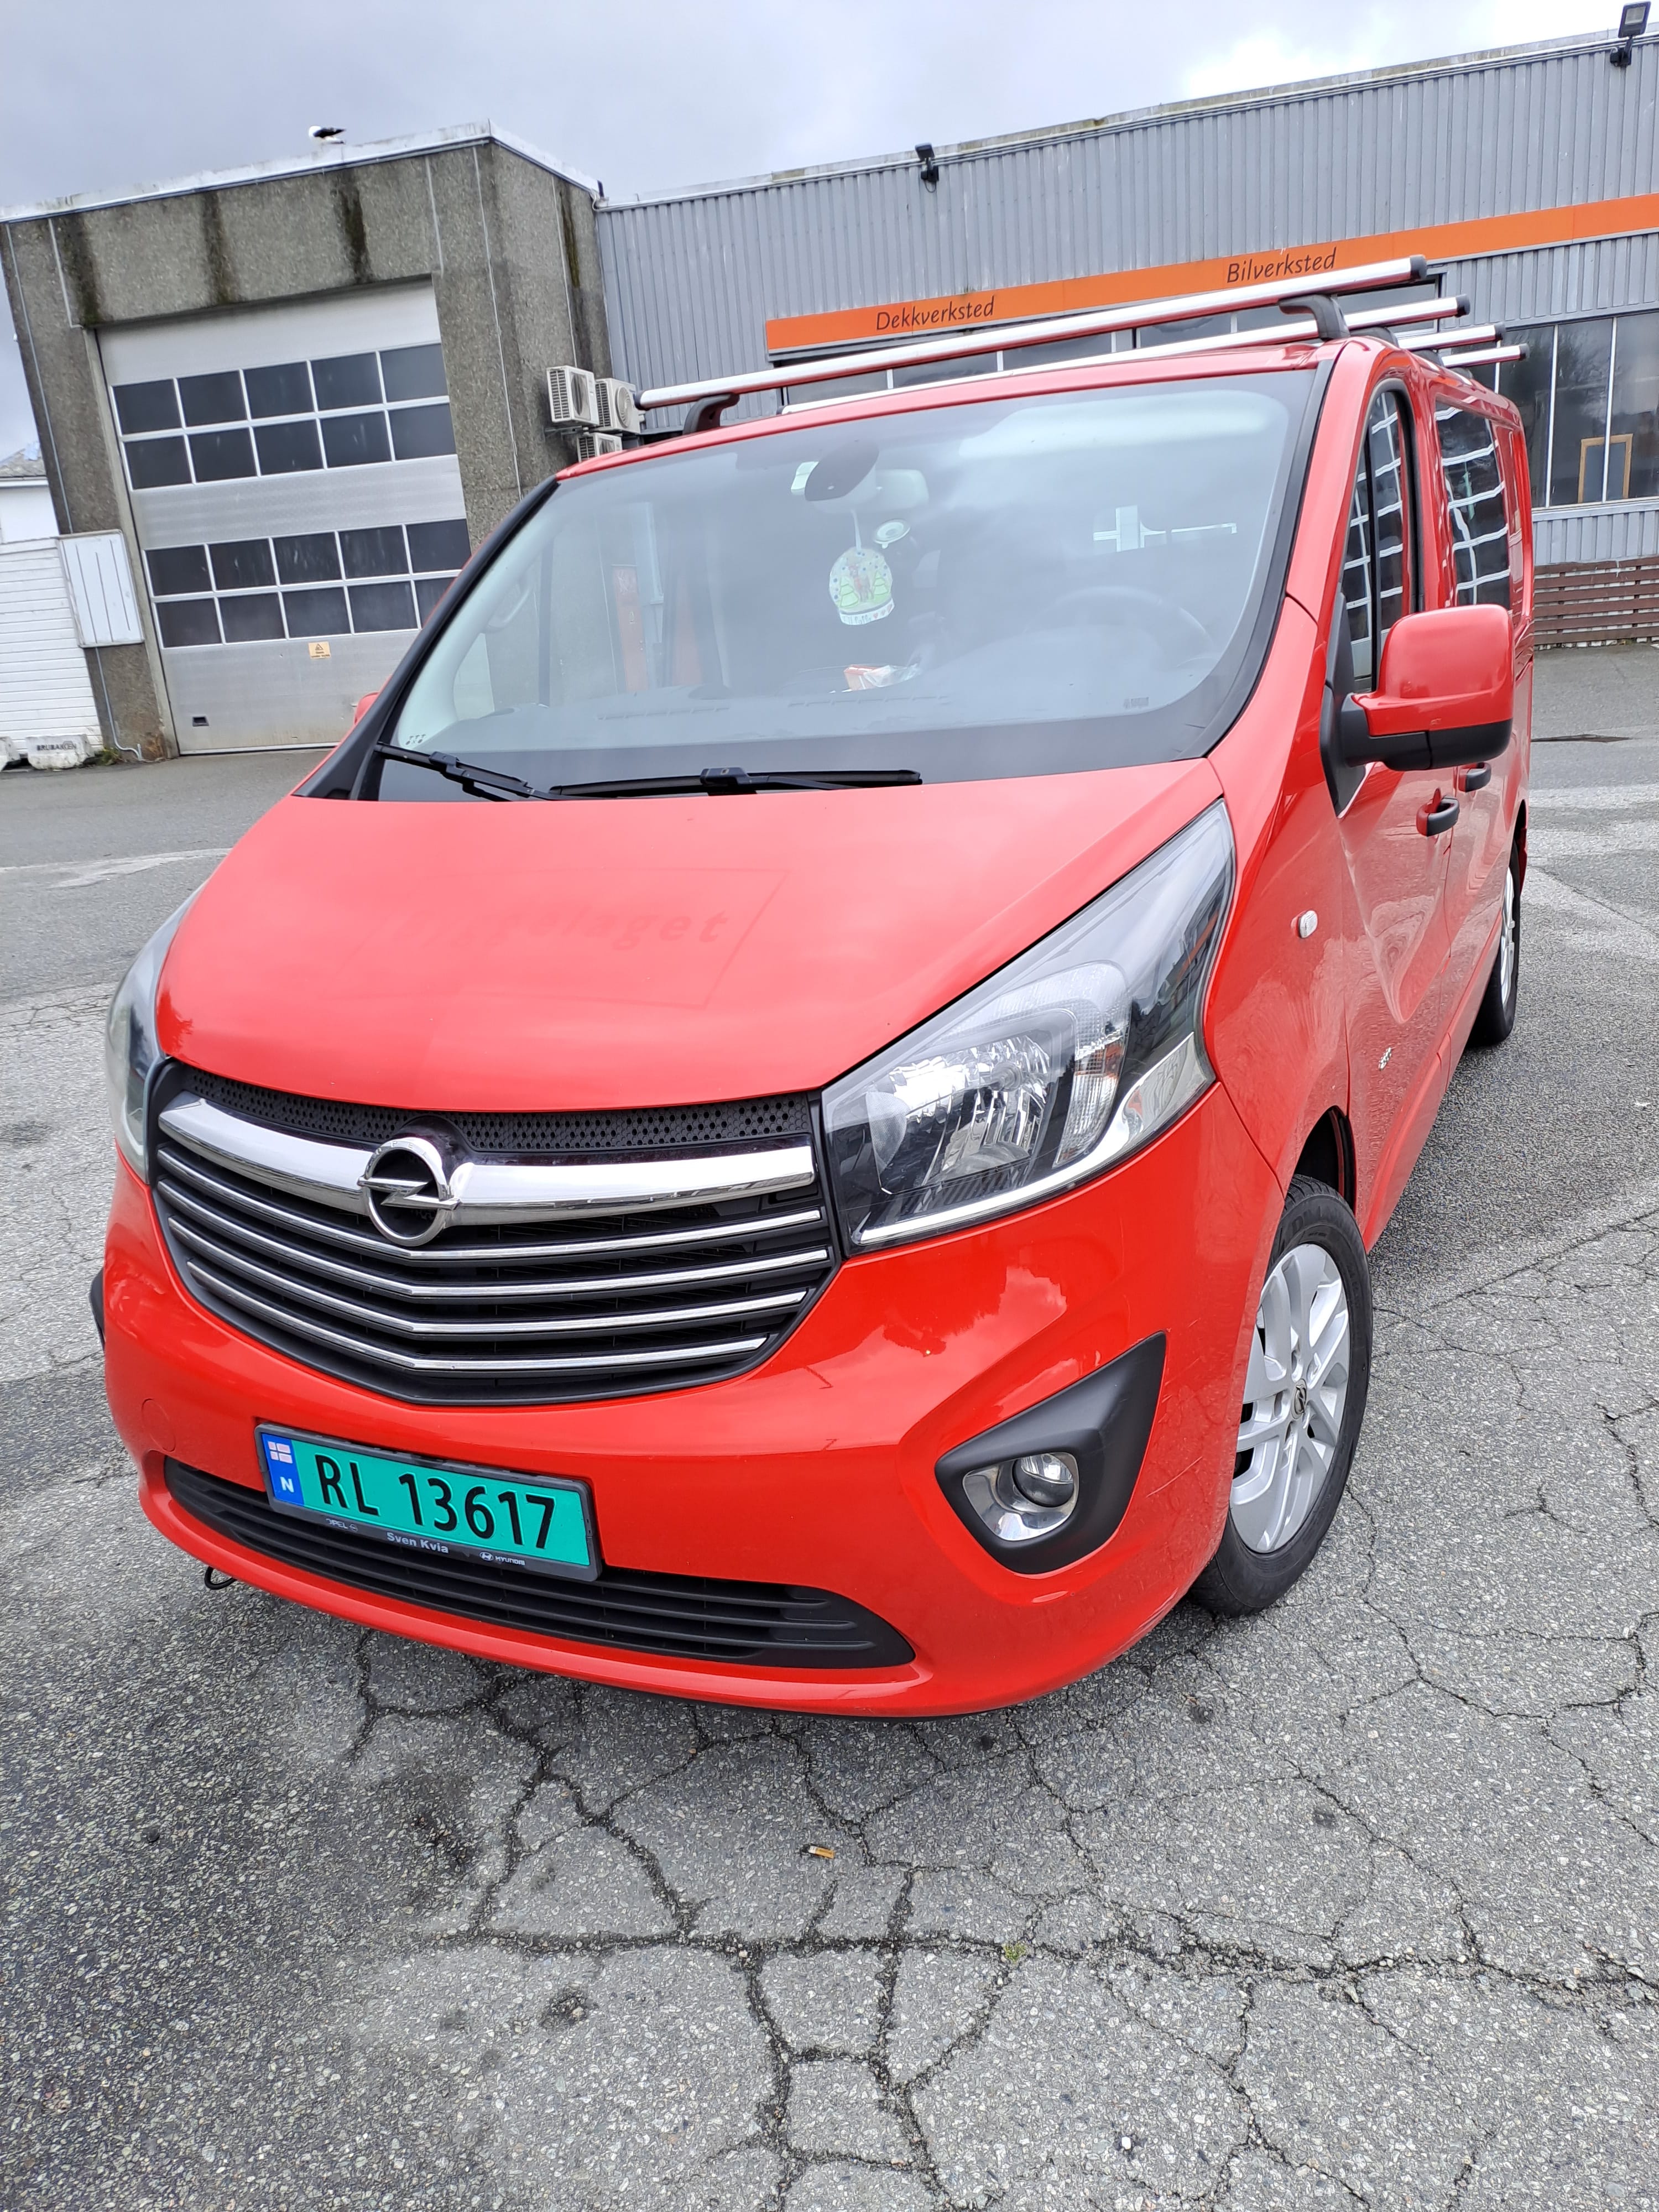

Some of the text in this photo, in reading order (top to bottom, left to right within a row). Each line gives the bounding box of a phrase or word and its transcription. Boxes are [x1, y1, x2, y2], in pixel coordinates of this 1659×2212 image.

[1227, 246, 1337, 283] Bilverksted
[876, 295, 994, 331] Dekkverksted
[281, 1476, 295, 1493] N
[315, 1453, 556, 1550] RL 13617
[387, 1531, 449, 1554] Sven Kvia
